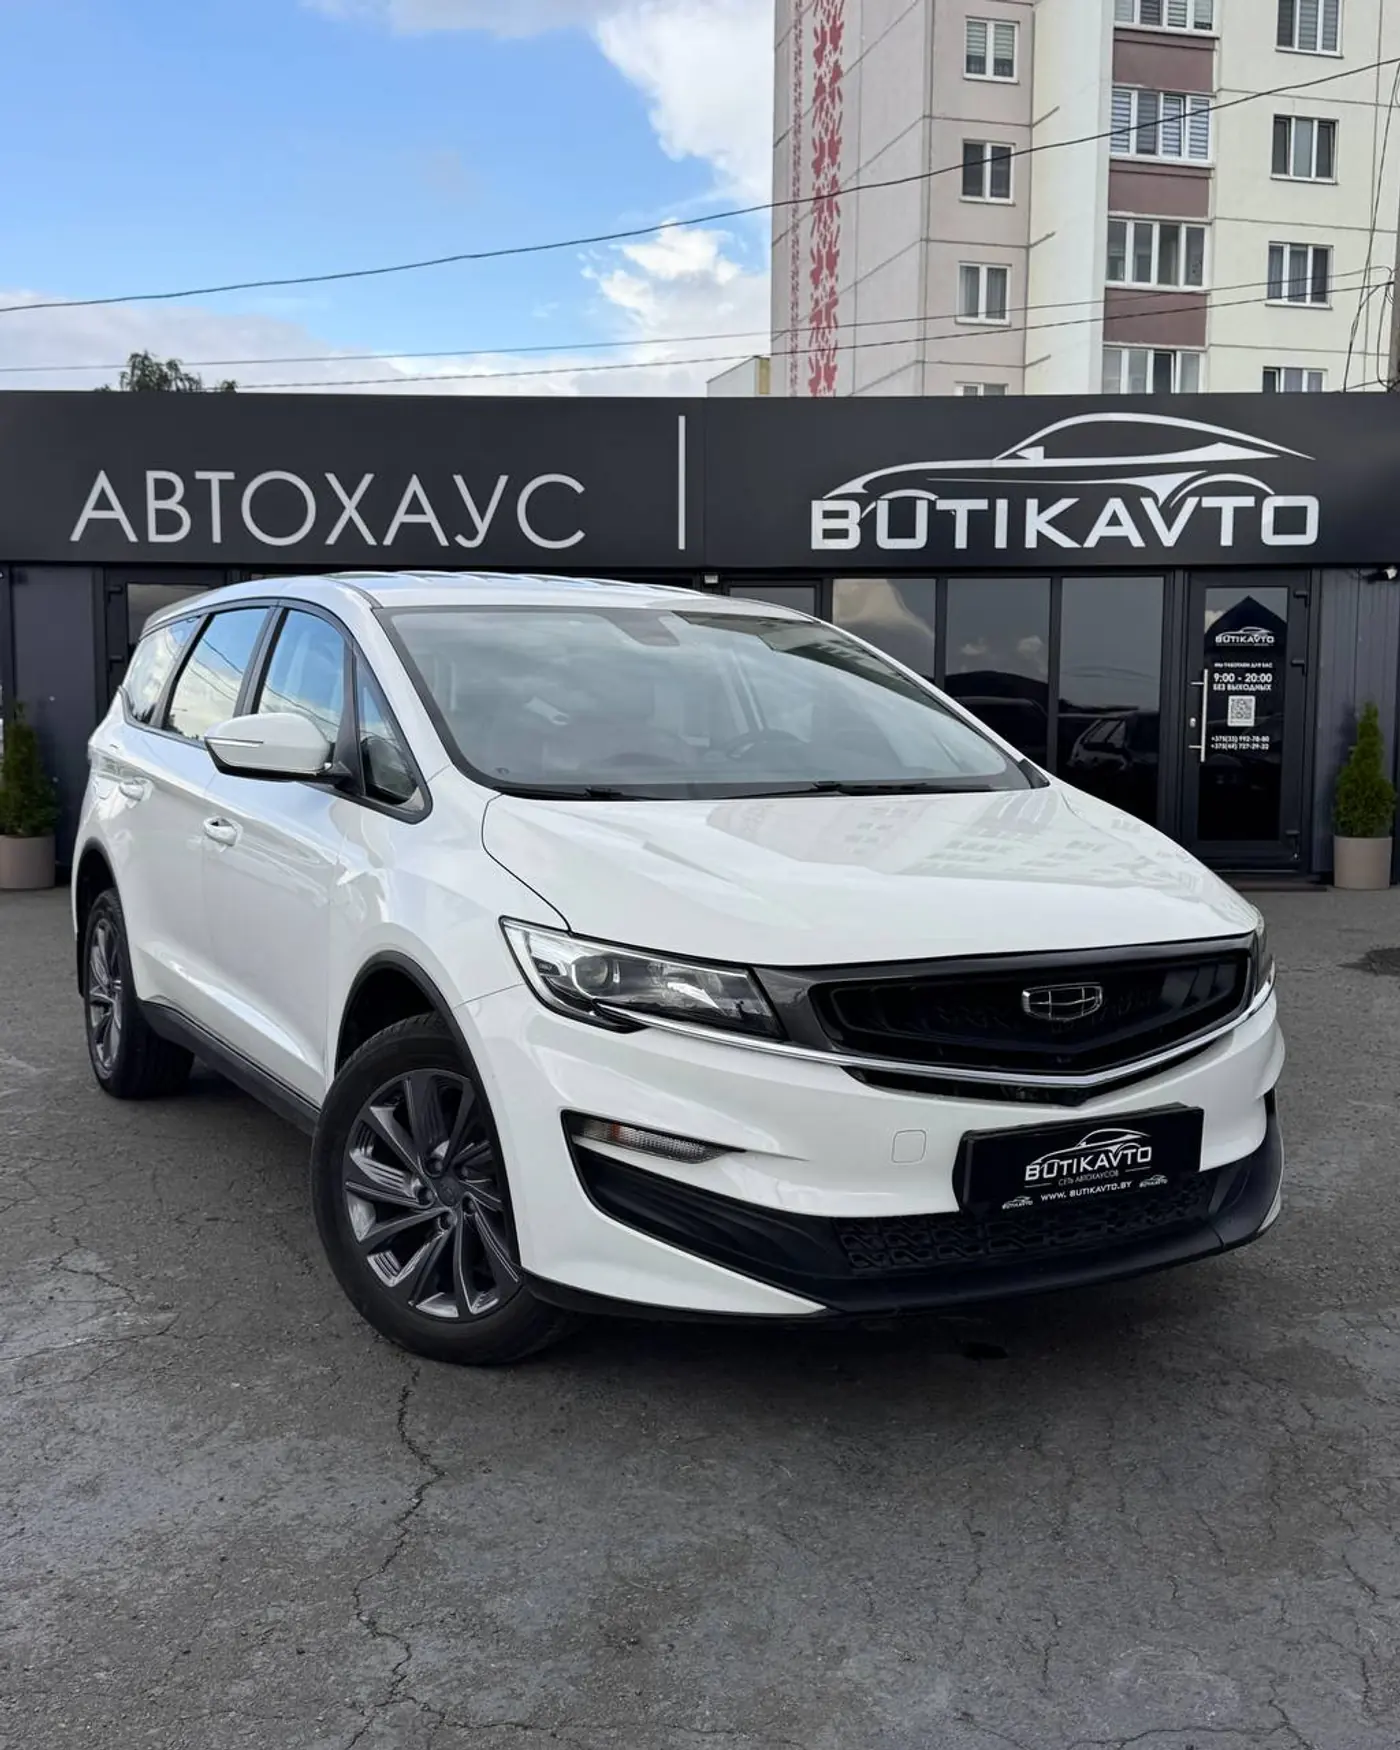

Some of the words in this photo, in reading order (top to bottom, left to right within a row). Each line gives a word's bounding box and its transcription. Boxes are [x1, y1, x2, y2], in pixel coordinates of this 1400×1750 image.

[70, 470, 587, 550] АВТОХАУС
[810, 495, 1320, 551] BUTIKAVTO
[1215, 635, 1275, 643] BUTIKAVTO
[1213, 673, 1235, 683] 9:00
[1244, 673, 1273, 683] 20:00
[1227, 684, 1272, 692] ВЫХОДНЫХ
[1024, 1146, 1153, 1181] BUTIKAVTO
[1075, 1169, 1120, 1184] АВТОХАУСОВ
